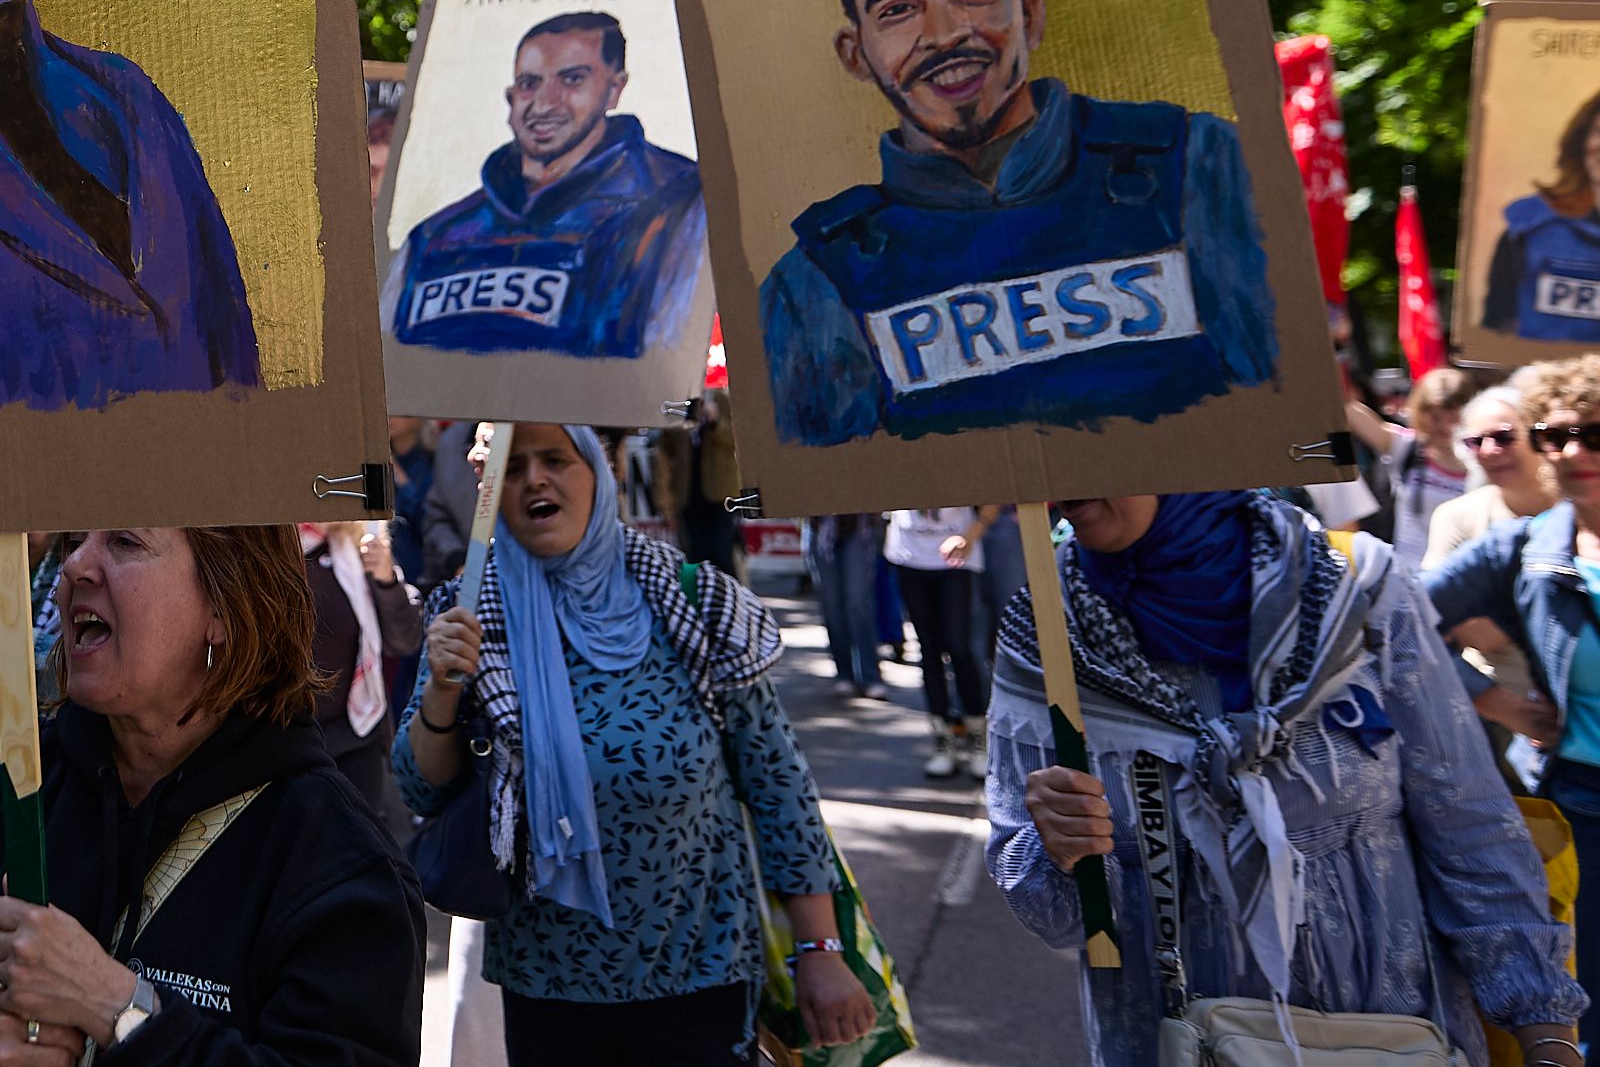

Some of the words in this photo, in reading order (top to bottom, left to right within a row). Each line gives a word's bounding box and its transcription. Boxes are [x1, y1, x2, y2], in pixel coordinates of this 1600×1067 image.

[416, 271, 561, 321] PRESS
[888, 260, 1164, 384] PRESS
[145, 966, 212, 992] VALLEKAS
[212, 982, 231, 994] CON
